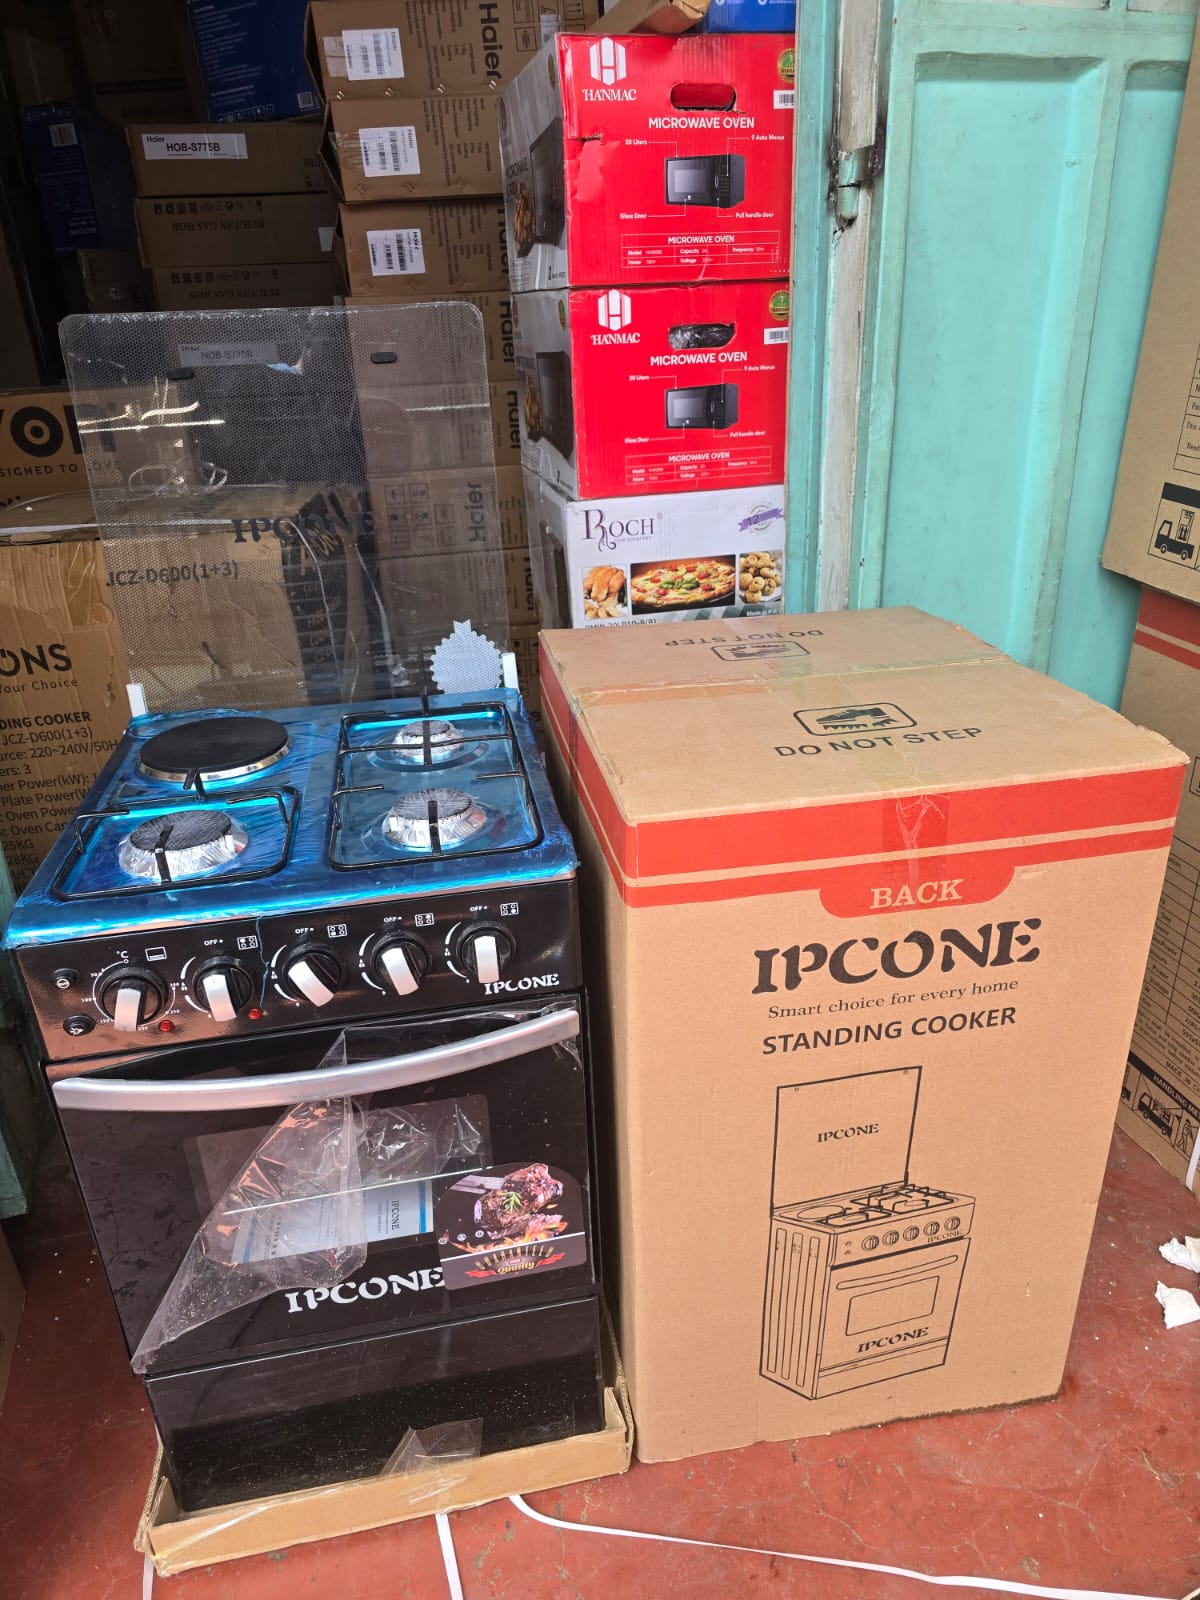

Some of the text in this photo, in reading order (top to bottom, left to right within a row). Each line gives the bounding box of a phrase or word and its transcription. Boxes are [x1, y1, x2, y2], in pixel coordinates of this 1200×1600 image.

[479, 2, 502, 80] Haier
[582, 88, 637, 101] HANMAC
[648, 117, 755, 129] MICROWAVE OVEN
[146, 135, 165, 143] Haier
[166, 143, 221, 152] HOB-S775B
[668, 235, 735, 244] MICROWAVE OVEN
[590, 332, 641, 346] HANMAC
[650, 352, 747, 366] MICROWAVE OVEN
[668, 452, 730, 463] MICROWAVE OVEN
[59, 464, 78, 473] TO
[465, 482, 487, 542] Haier
[665, 628, 825, 648] DO NOT STEP
[32, 679, 79, 691] Choice
[35, 711, 92, 726] COOKER
[2, 726, 93, 747] JCZ-D600(1+3)
[774, 727, 983, 758] DO NOT STEP
[23, 764, 32, 774] 3
[18, 773, 89, 791] Power(kW):
[6, 810, 39, 821] Oven
[11, 823, 43, 836] Oven
[869, 879, 964, 910] BACK
[203, 938, 218, 946] OFF
[751, 918, 1042, 994] IPCONE
[484, 973, 560, 995] IPCONE
[768, 979, 1019, 1019] Smart choice for every home
[762, 1006, 1017, 1055] STANDING COOKER
[1152, 1073, 1189, 1107] HANDLING
[817, 1123, 879, 1143] IPCONE
[391, 1199, 400, 1231] IPCONE
[926, 1229, 964, 1244] IPCONE
[283, 1266, 446, 1314] IPCONE
[857, 1327, 929, 1353] IPCONE
